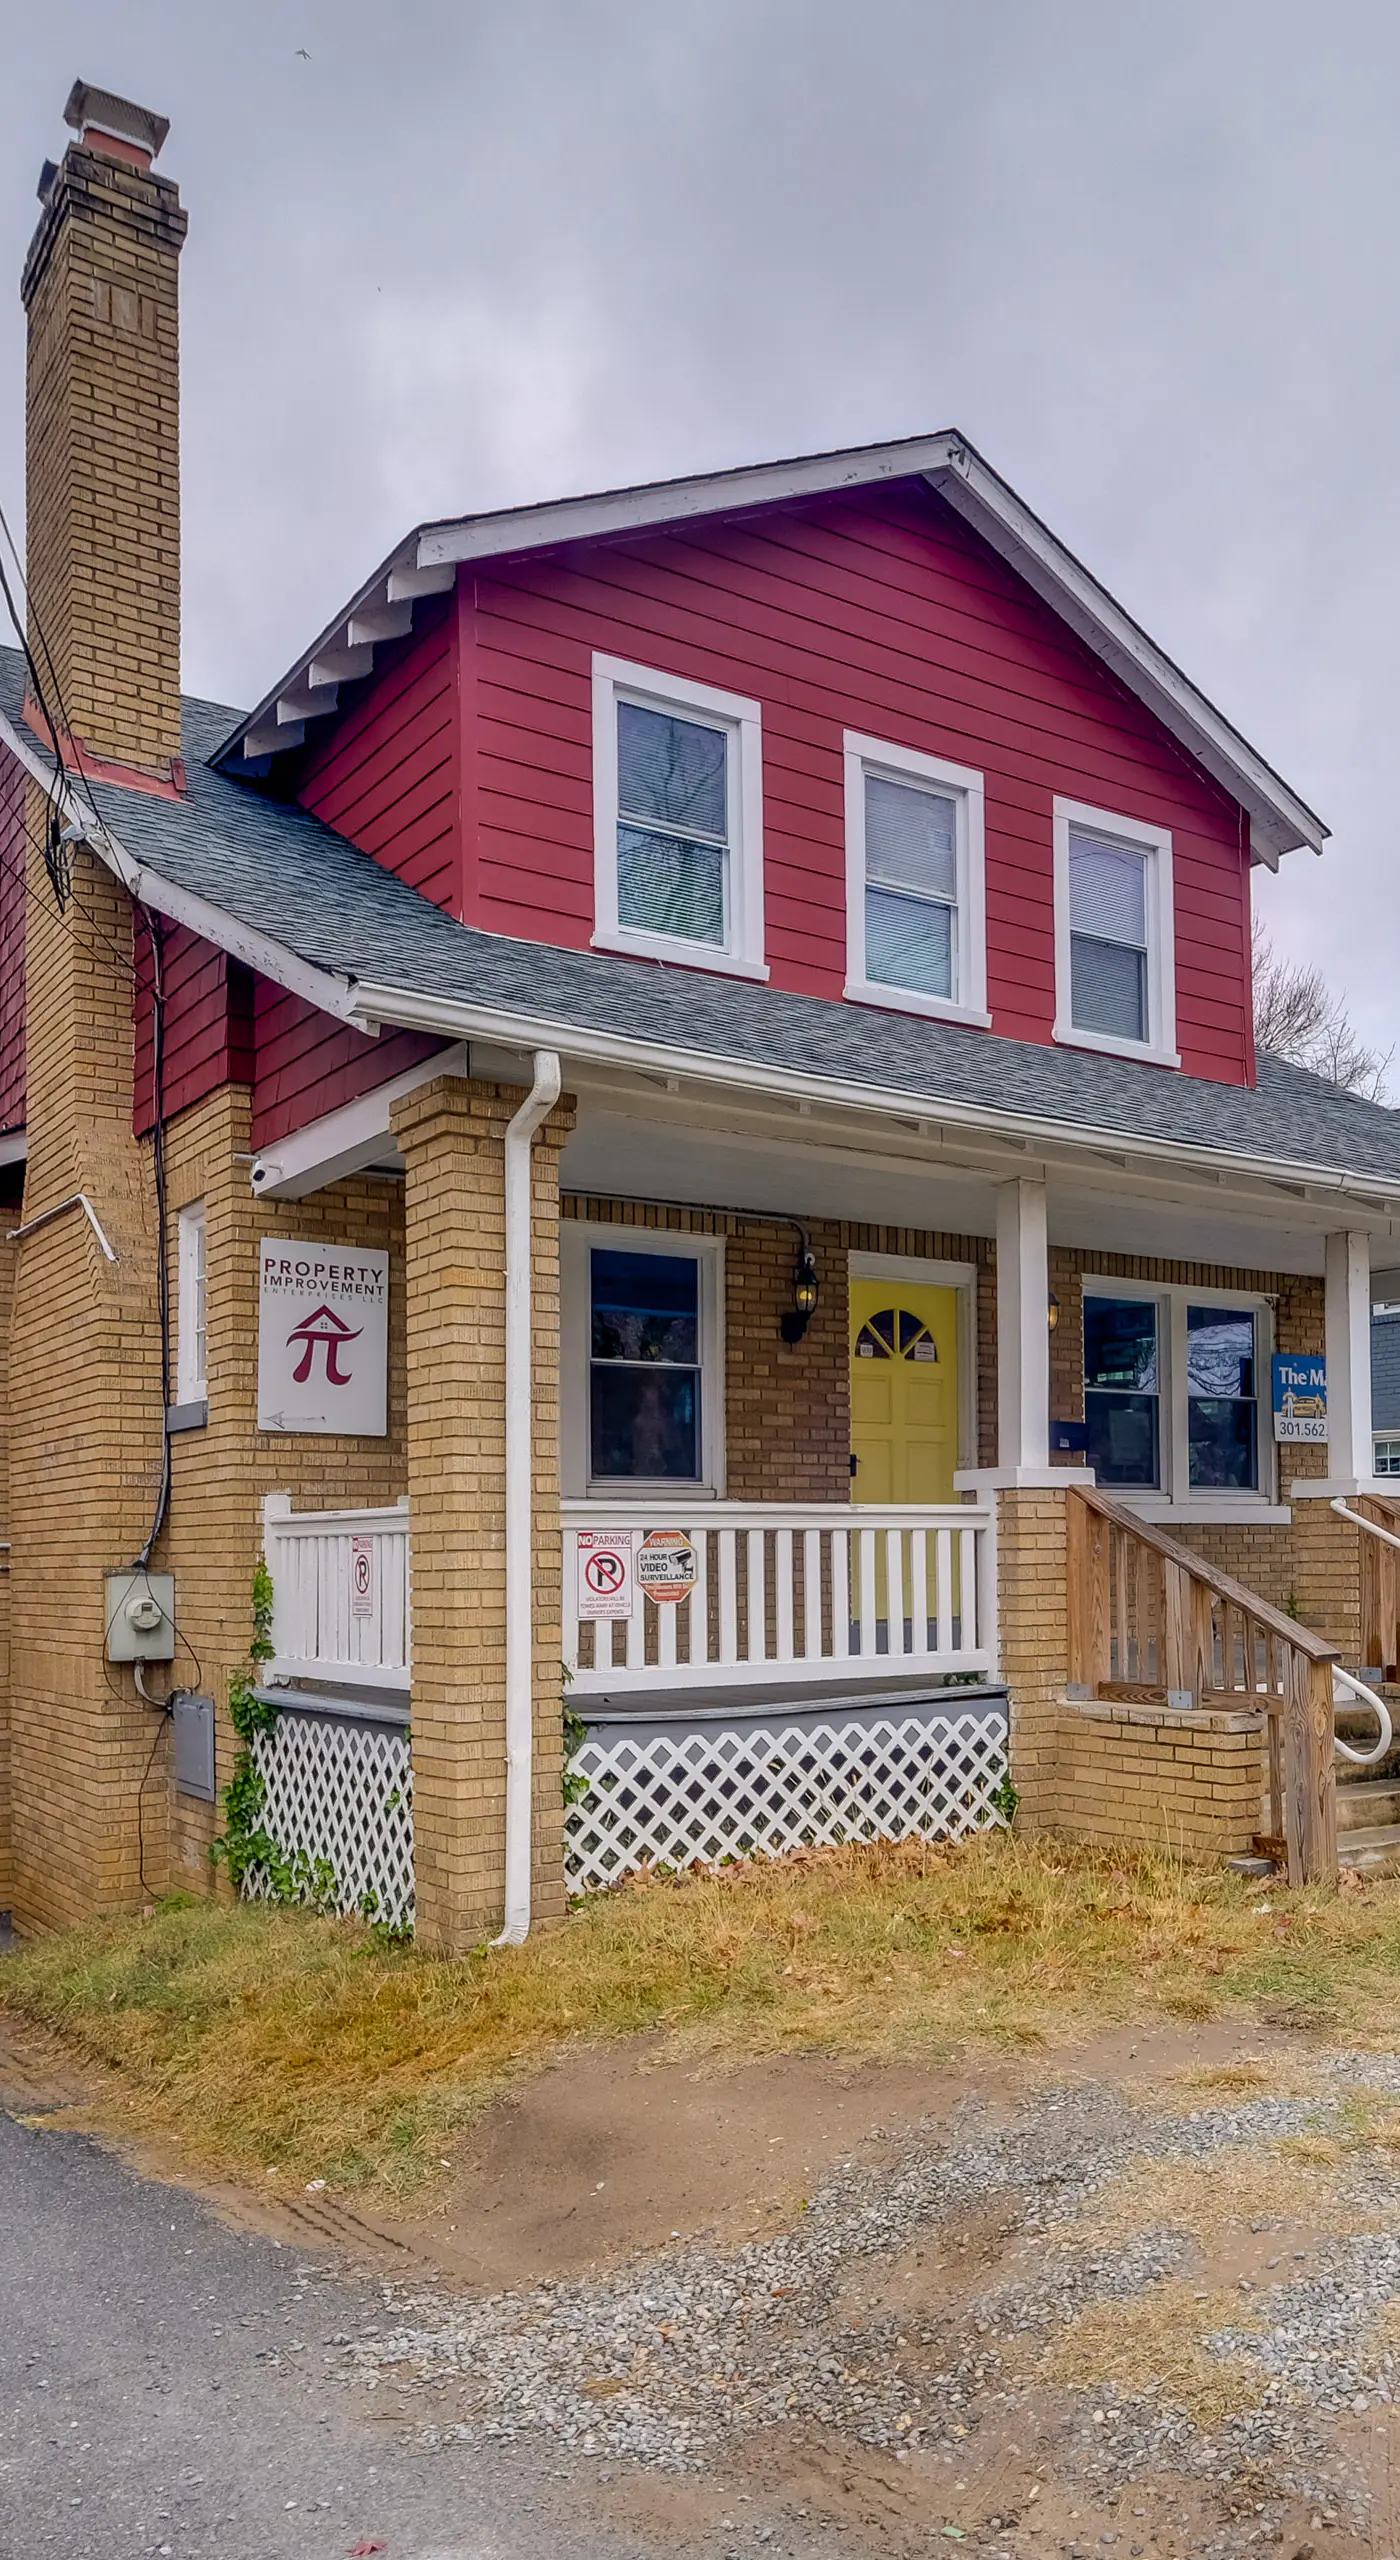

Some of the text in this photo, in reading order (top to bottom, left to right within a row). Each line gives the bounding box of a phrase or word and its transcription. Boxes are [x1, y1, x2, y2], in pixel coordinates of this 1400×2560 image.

[264, 1258, 384, 1284] PROPERTY
[263, 1275, 385, 1296] IMPROVEMENT
[263, 1286, 384, 1304] ENTERPRISES LLC
[1278, 1366, 1308, 1387] The
[578, 1534, 631, 1546] NO PARKING
[650, 1537, 684, 1547] WARNING
[649, 1553, 668, 1561] HOUR
[640, 1562, 668, 1572] VIDEO
[640, 1573, 694, 1582] SURVEILLANCE
